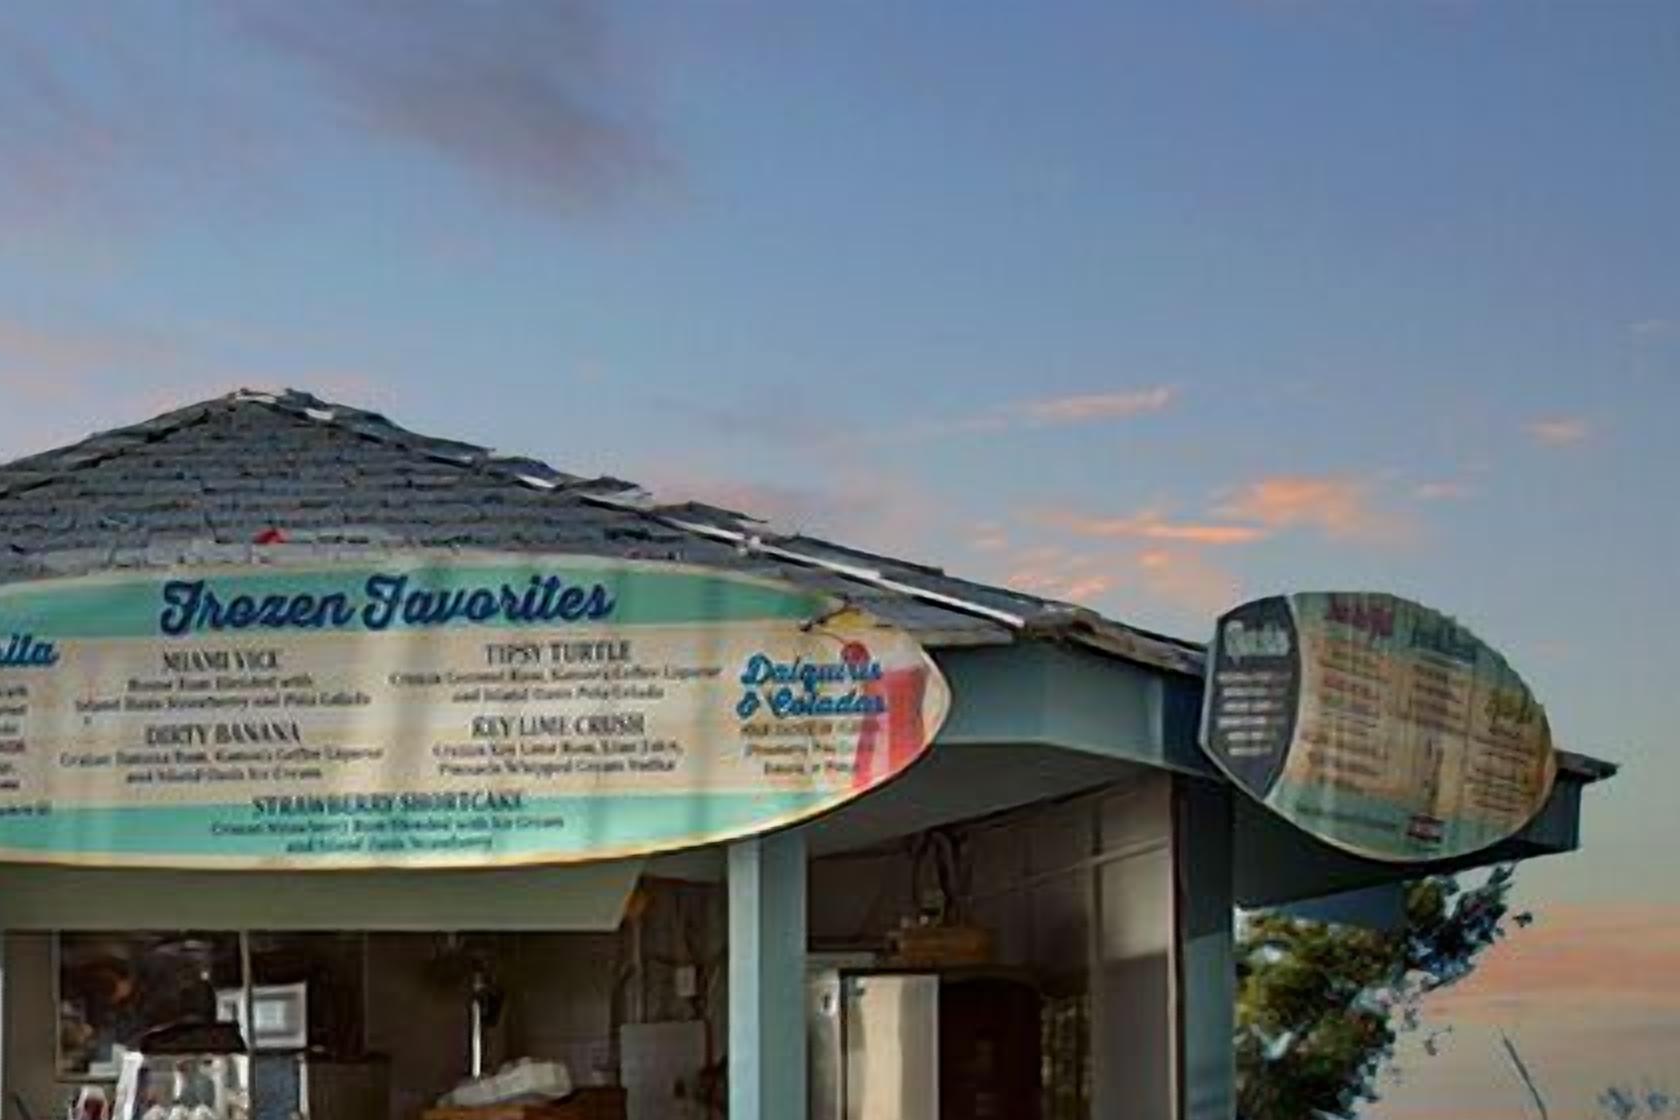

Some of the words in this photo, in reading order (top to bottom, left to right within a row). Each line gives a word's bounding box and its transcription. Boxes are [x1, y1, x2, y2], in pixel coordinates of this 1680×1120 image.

[161, 580, 355, 634] Frozen
[363, 574, 617, 630] Favorites
[163, 651, 228, 671] MIAMI
[486, 644, 545, 664] TIPSY
[551, 641, 632, 661] TURTLE
[771, 687, 886, 718] Coladas
[147, 724, 207, 744] DIRTY
[215, 723, 301, 743] BANANA
[472, 716, 510, 737] KEY
[520, 715, 566, 735] LIME
[574, 713, 645, 735] CRUSH
[252, 794, 393, 814] STRAWBERRY
[398, 789, 522, 812] SHORTCAKE
